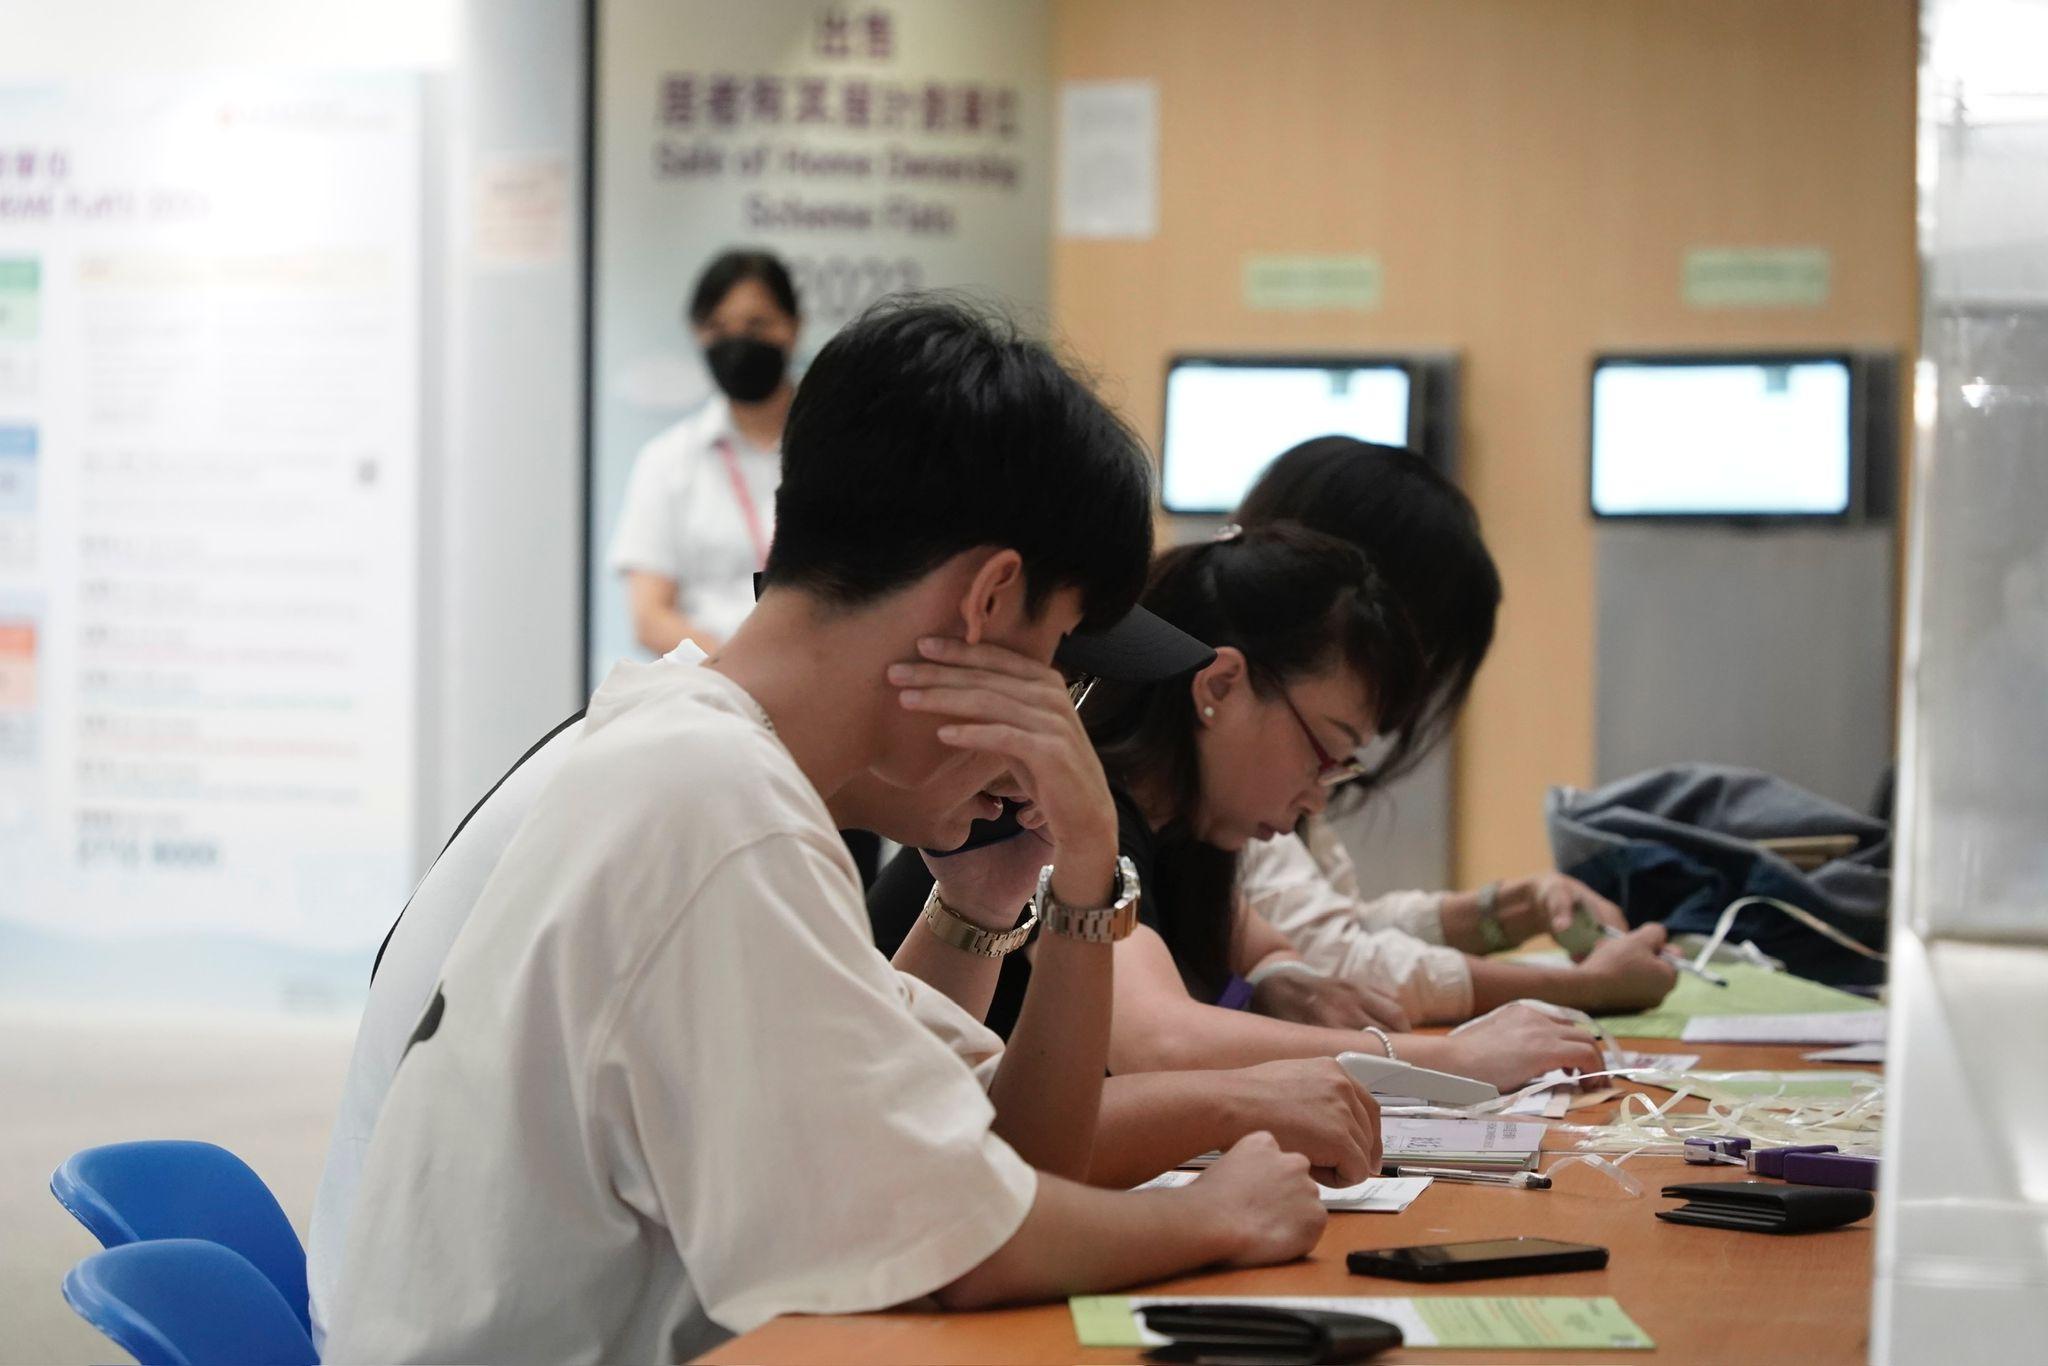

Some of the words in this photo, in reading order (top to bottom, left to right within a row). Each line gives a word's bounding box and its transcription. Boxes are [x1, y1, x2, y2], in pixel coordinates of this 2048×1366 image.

[657, 143, 724, 176] Sale
[739, 144, 770, 176] of
[783, 147, 872, 176] Home
[746, 194, 873, 229] Scheme
